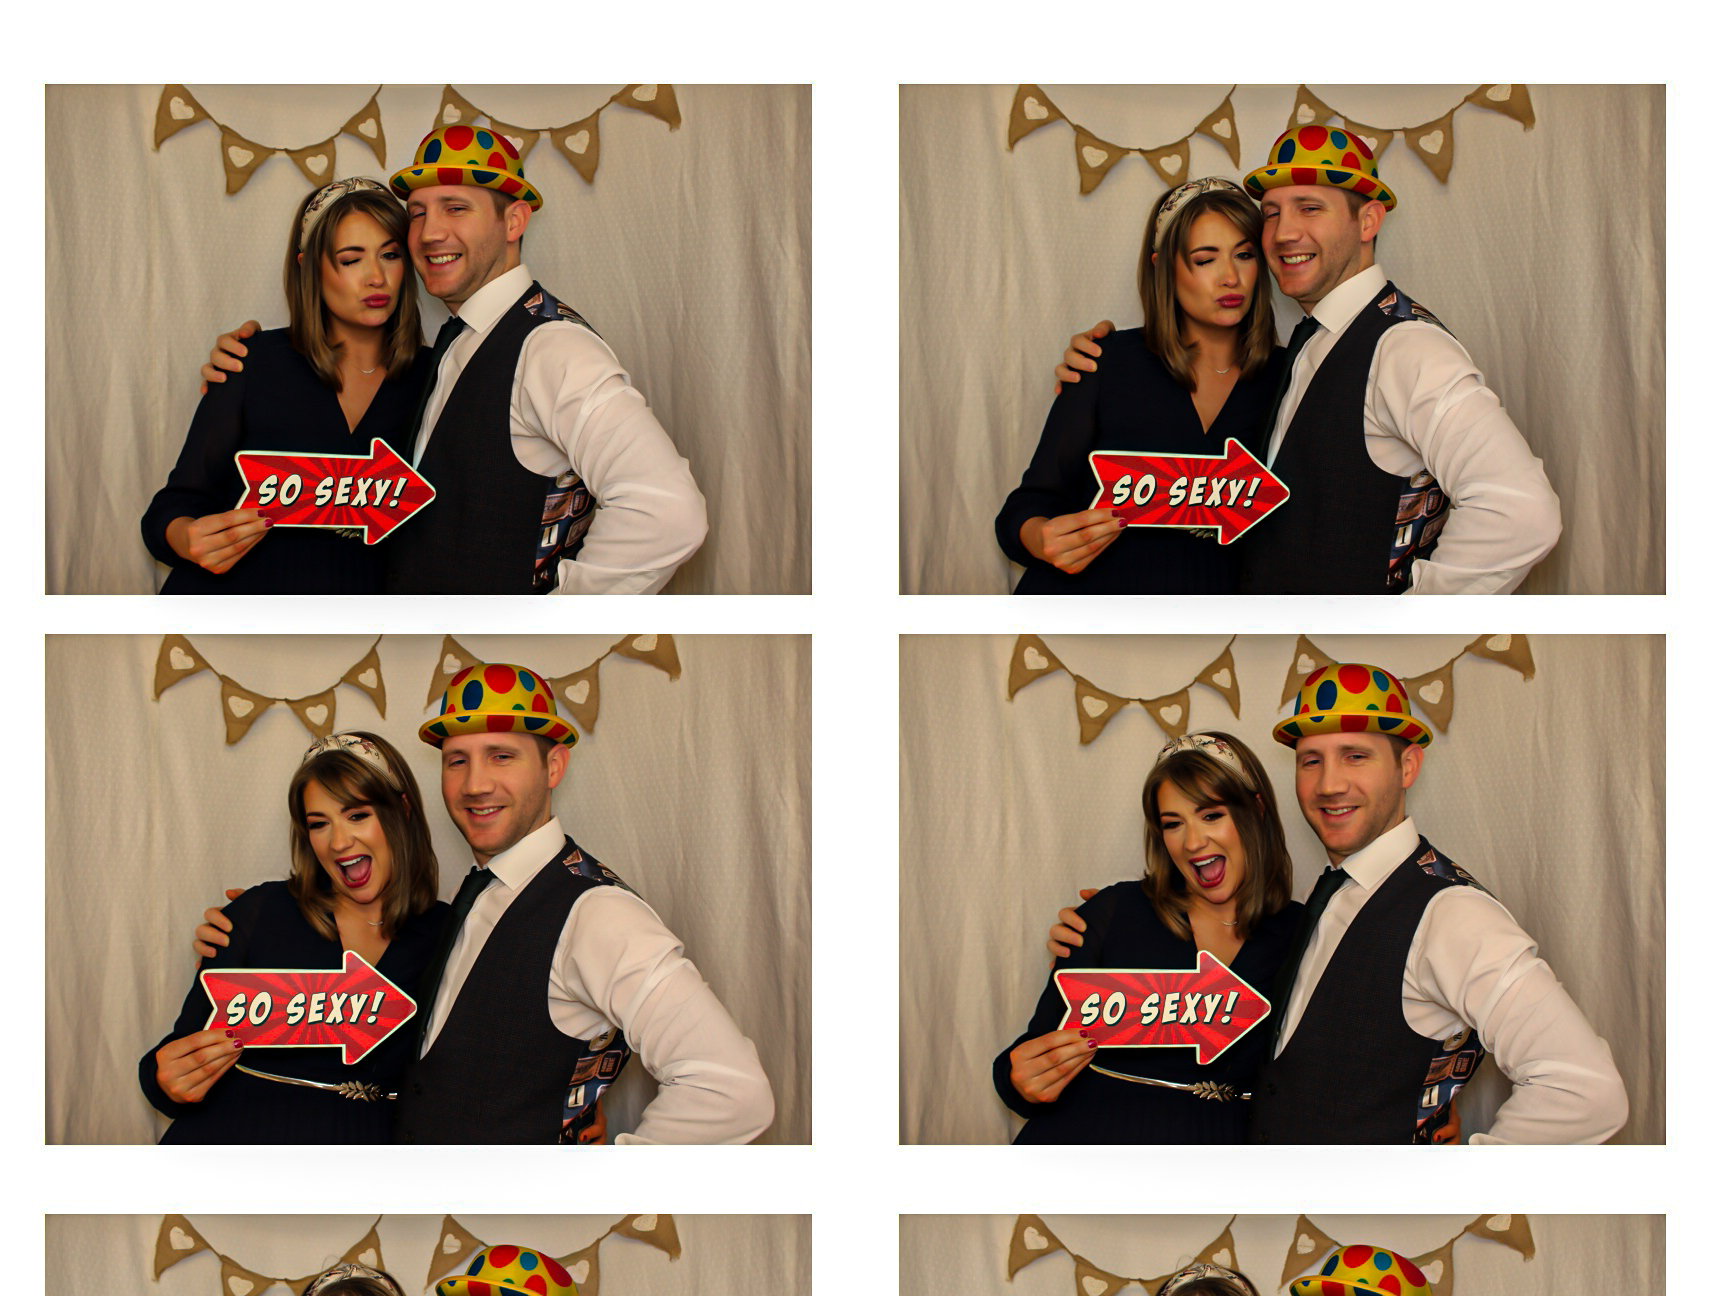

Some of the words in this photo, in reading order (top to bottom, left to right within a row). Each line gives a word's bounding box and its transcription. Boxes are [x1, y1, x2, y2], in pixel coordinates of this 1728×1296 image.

[258, 474, 302, 506] SO
[314, 476, 408, 508] SEXY!
[1112, 474, 1156, 506] SO
[1168, 476, 1262, 508] SEXY!
[226, 991, 273, 1026] SO
[286, 991, 386, 1026] SEXY!
[1080, 991, 1127, 1026] SO
[1140, 991, 1240, 1026] SEXY!
